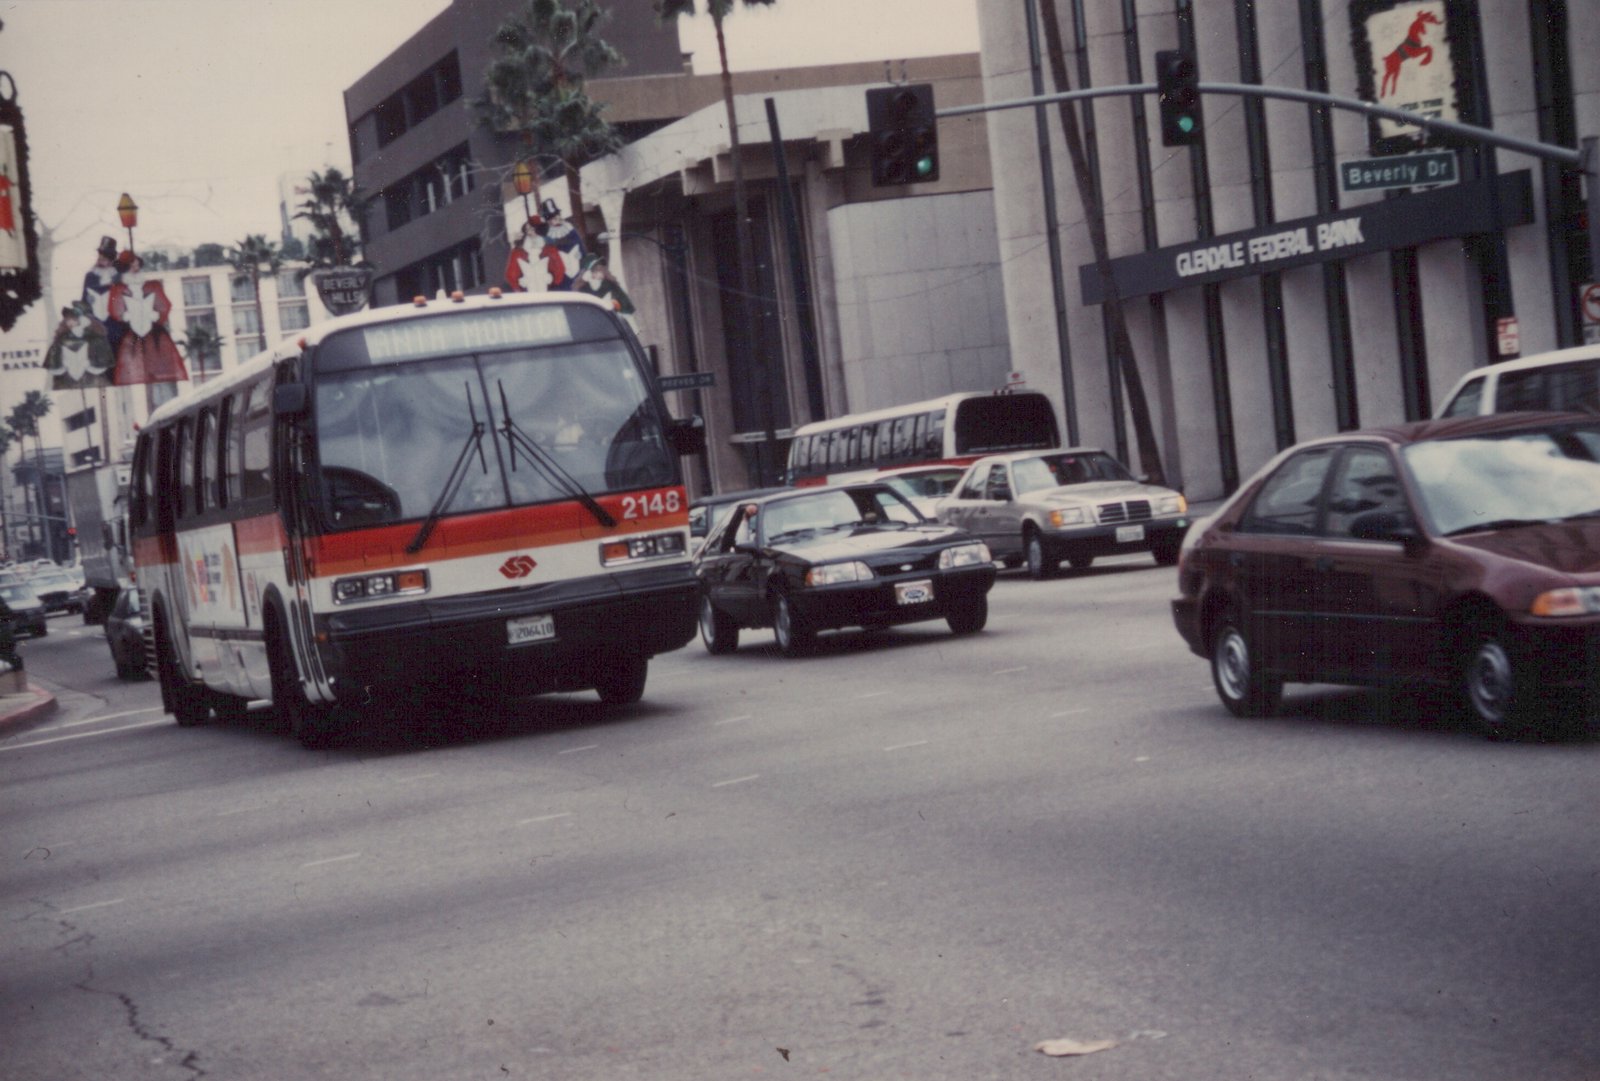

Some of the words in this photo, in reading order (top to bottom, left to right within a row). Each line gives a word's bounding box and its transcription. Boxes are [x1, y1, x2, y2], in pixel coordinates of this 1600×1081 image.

[1348, 163, 1418, 184] Beverly
[1427, 160, 1448, 177] Dr
[1176, 241, 1245, 277] GLENDALE
[1248, 228, 1315, 264] FEDERAL
[1317, 217, 1366, 251] BANK
[323, 276, 366, 290] BEVERLY
[331, 290, 361, 304] HILLS
[621, 490, 681, 520] 2148
